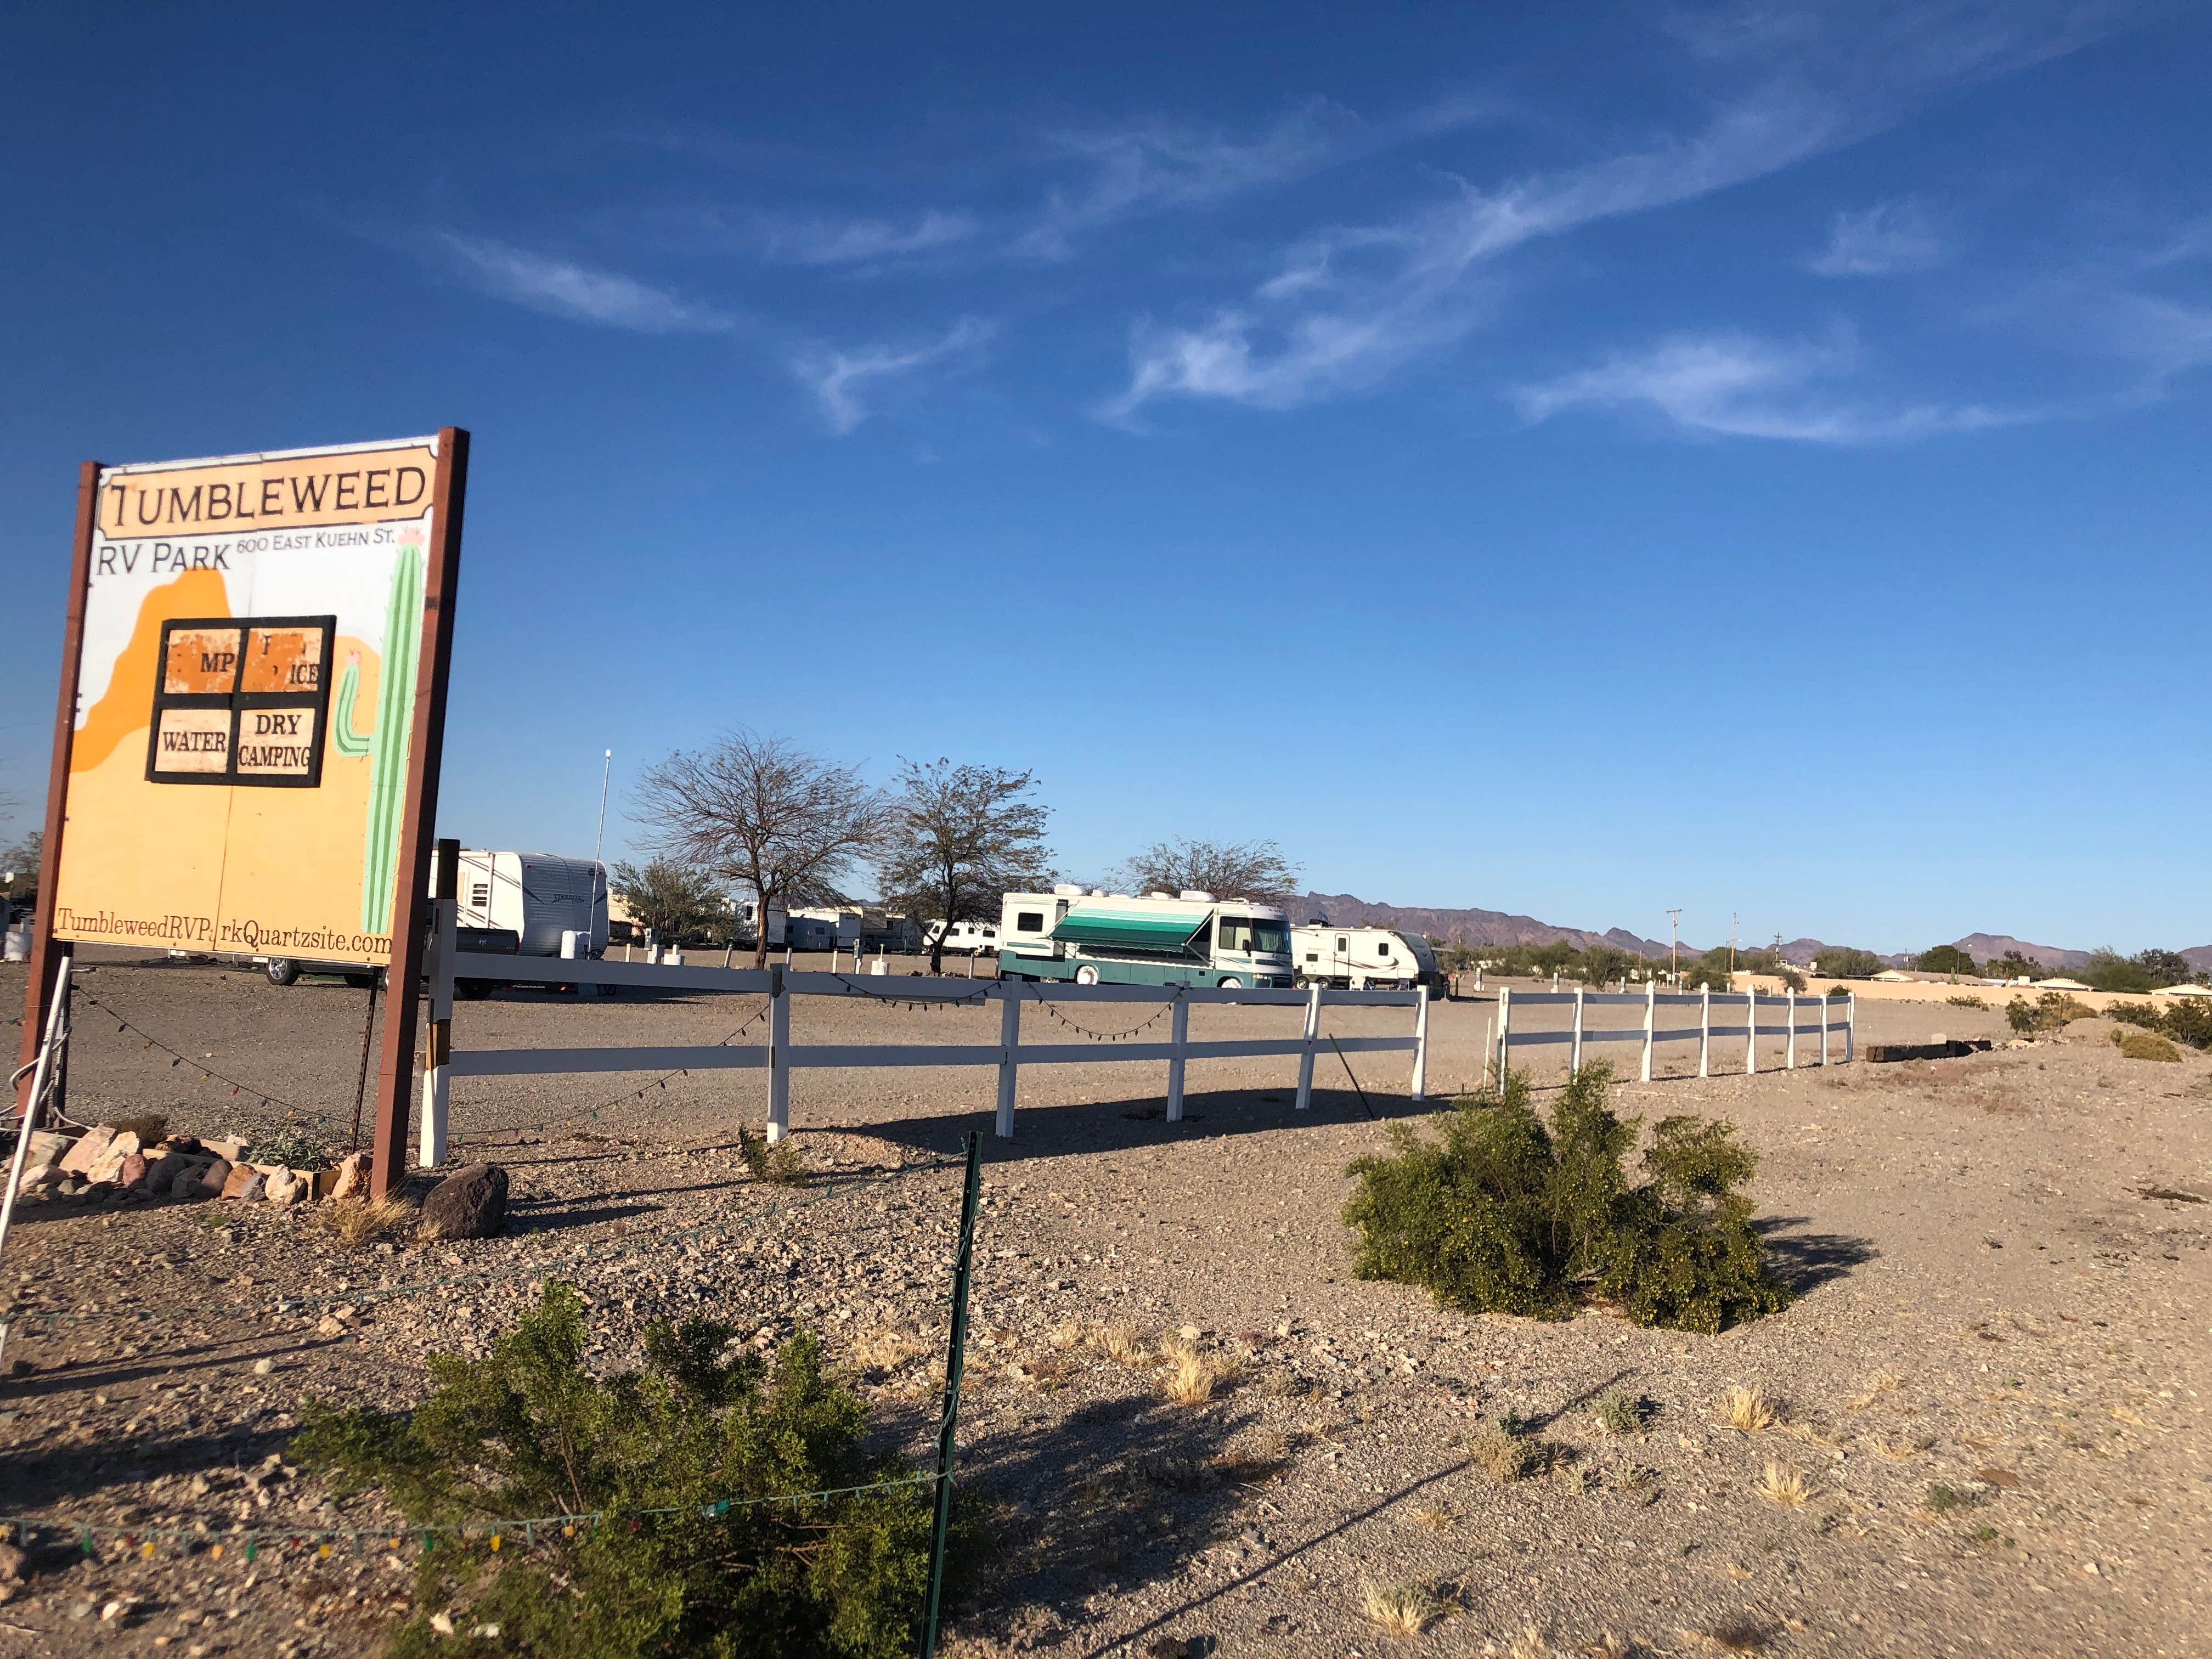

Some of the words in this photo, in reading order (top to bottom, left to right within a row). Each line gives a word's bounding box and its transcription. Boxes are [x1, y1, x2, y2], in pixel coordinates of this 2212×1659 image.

[111, 466, 426, 526] TUMBLEWEED
[236, 537, 268, 553] 600
[272, 534, 311, 550] EAST
[315, 531, 369, 549] KUEHN
[373, 528, 395, 544] ST.
[97, 544, 142, 575] RV
[150, 542, 231, 573] PARK
[255, 714, 302, 735] DRY
[162, 731, 227, 752] WATER
[238, 746, 312, 768] CAMPING
